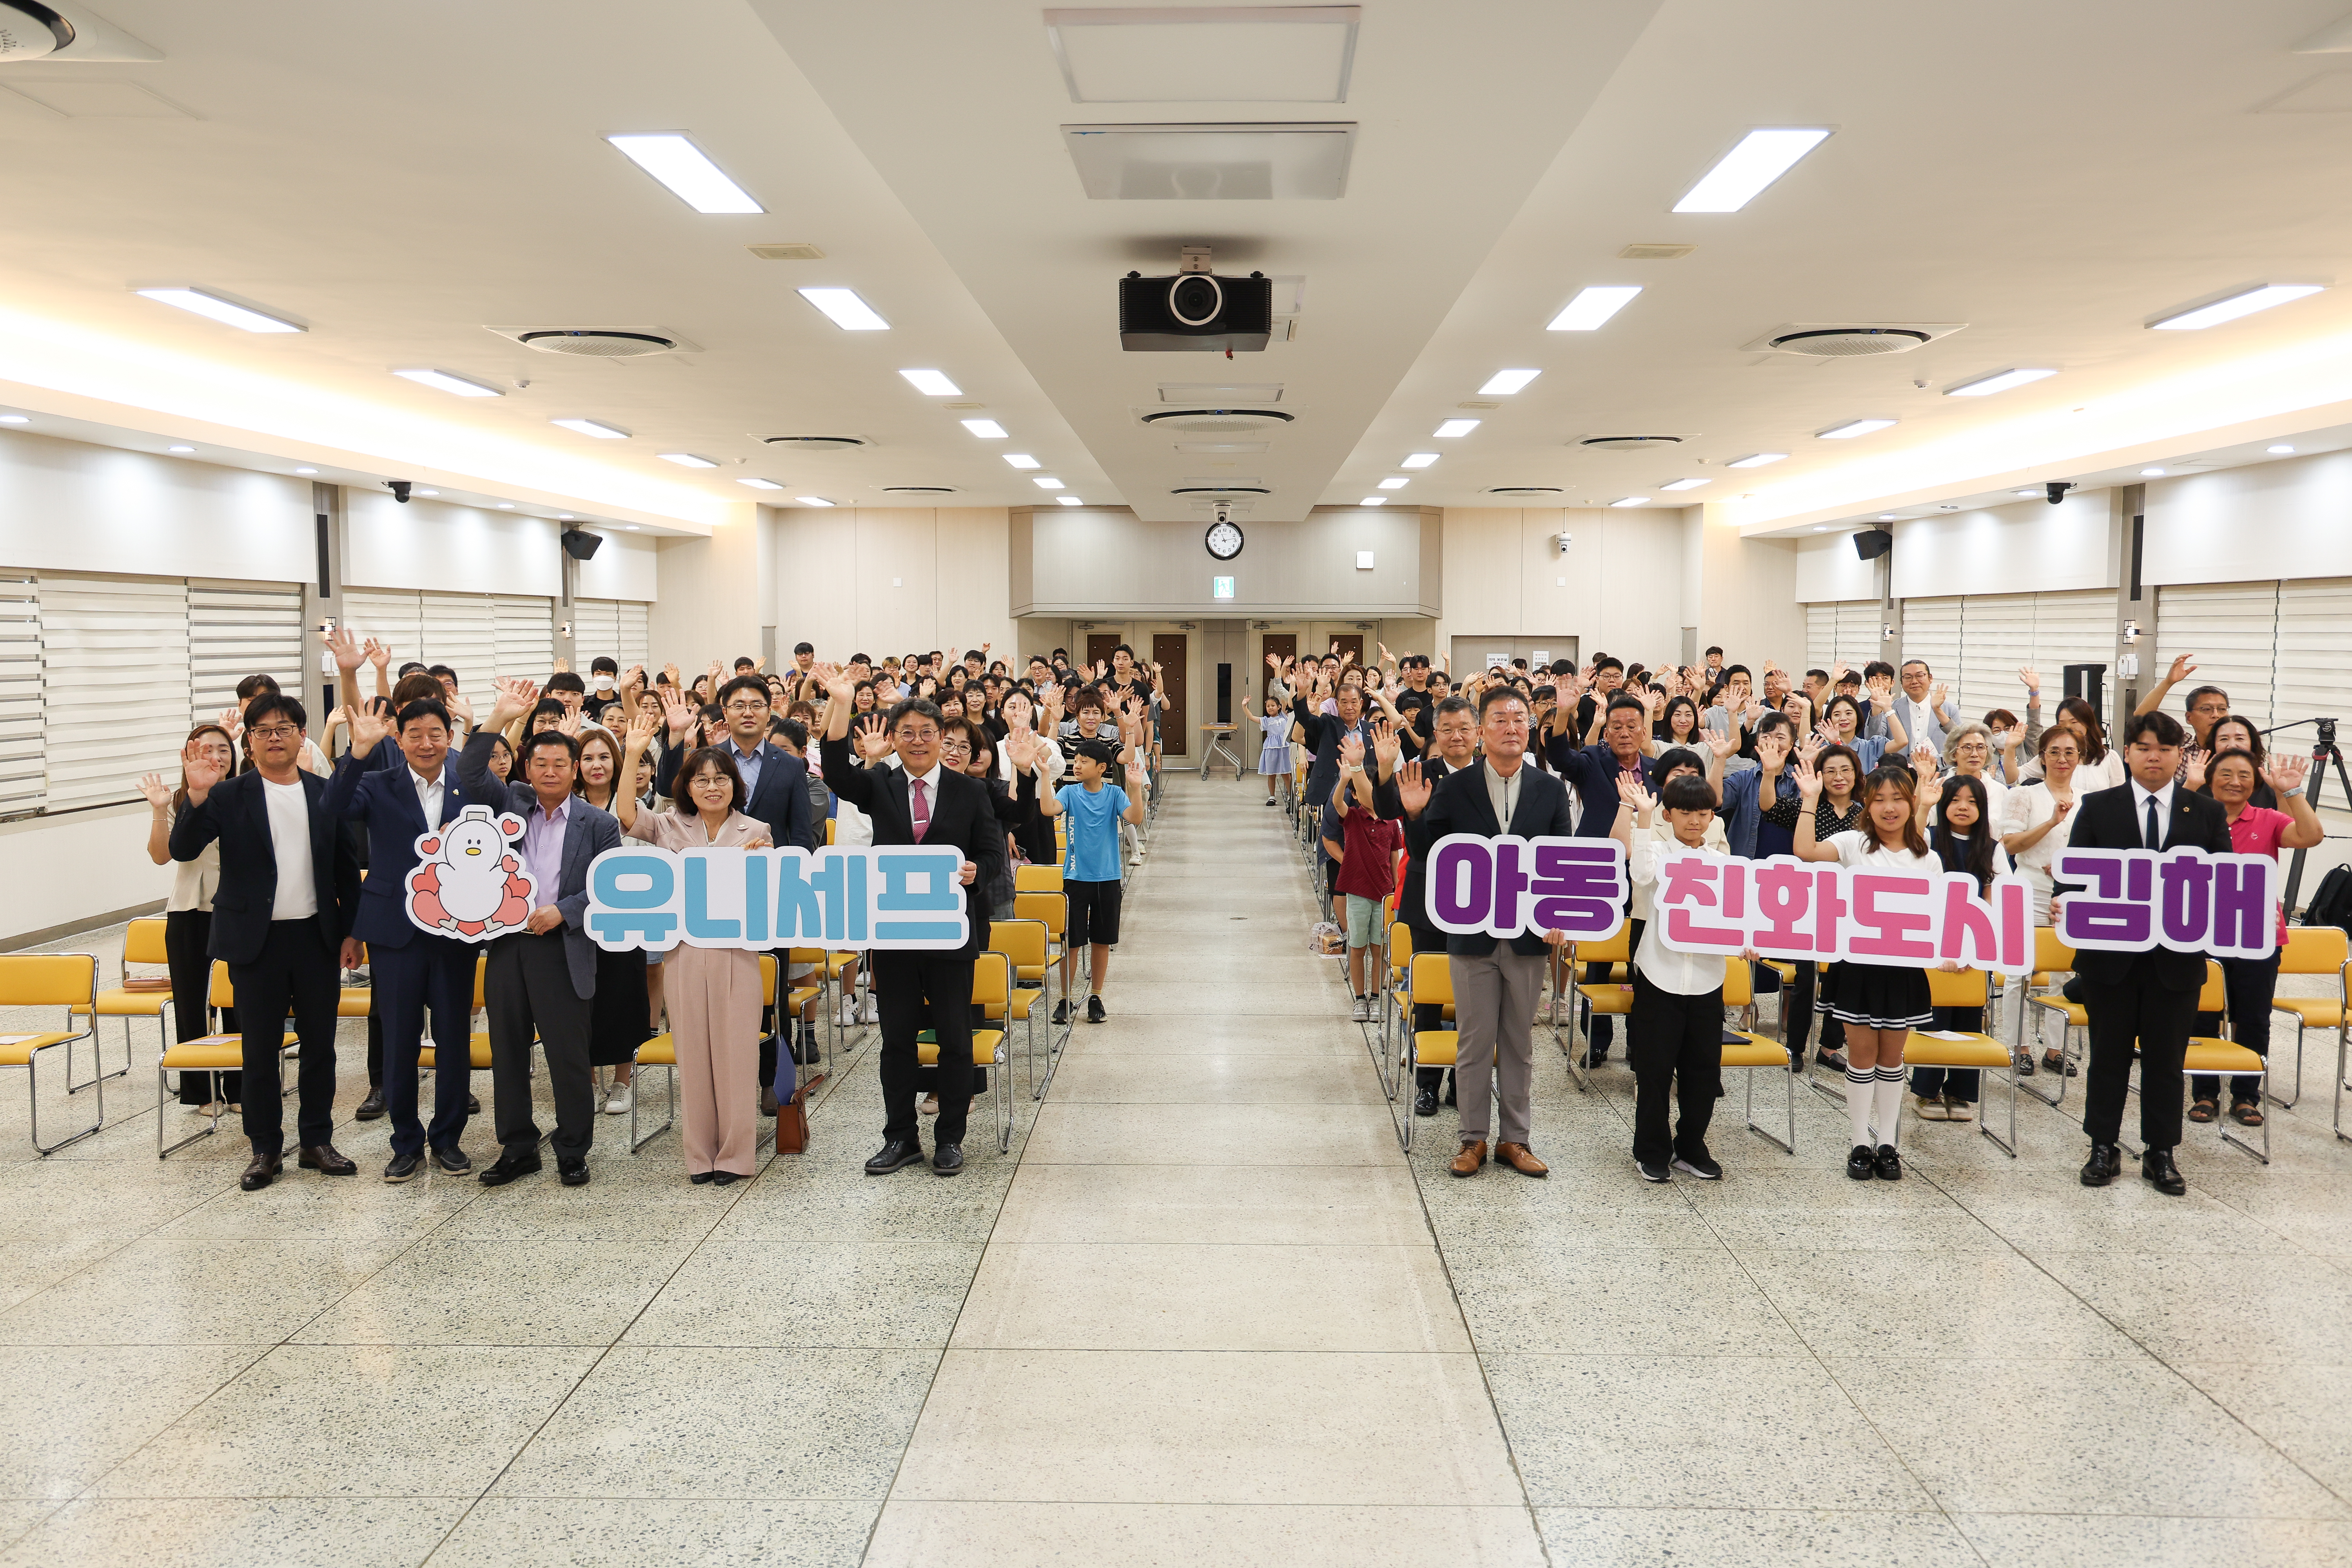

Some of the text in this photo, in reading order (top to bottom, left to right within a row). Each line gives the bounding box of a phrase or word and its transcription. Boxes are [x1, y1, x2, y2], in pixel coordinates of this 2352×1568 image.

[591, 855, 962, 942] 유니세프
[1435, 843, 1619, 931] 아동
[1663, 858, 2024, 966] 친화도시
[2062, 855, 2266, 949] 김해
